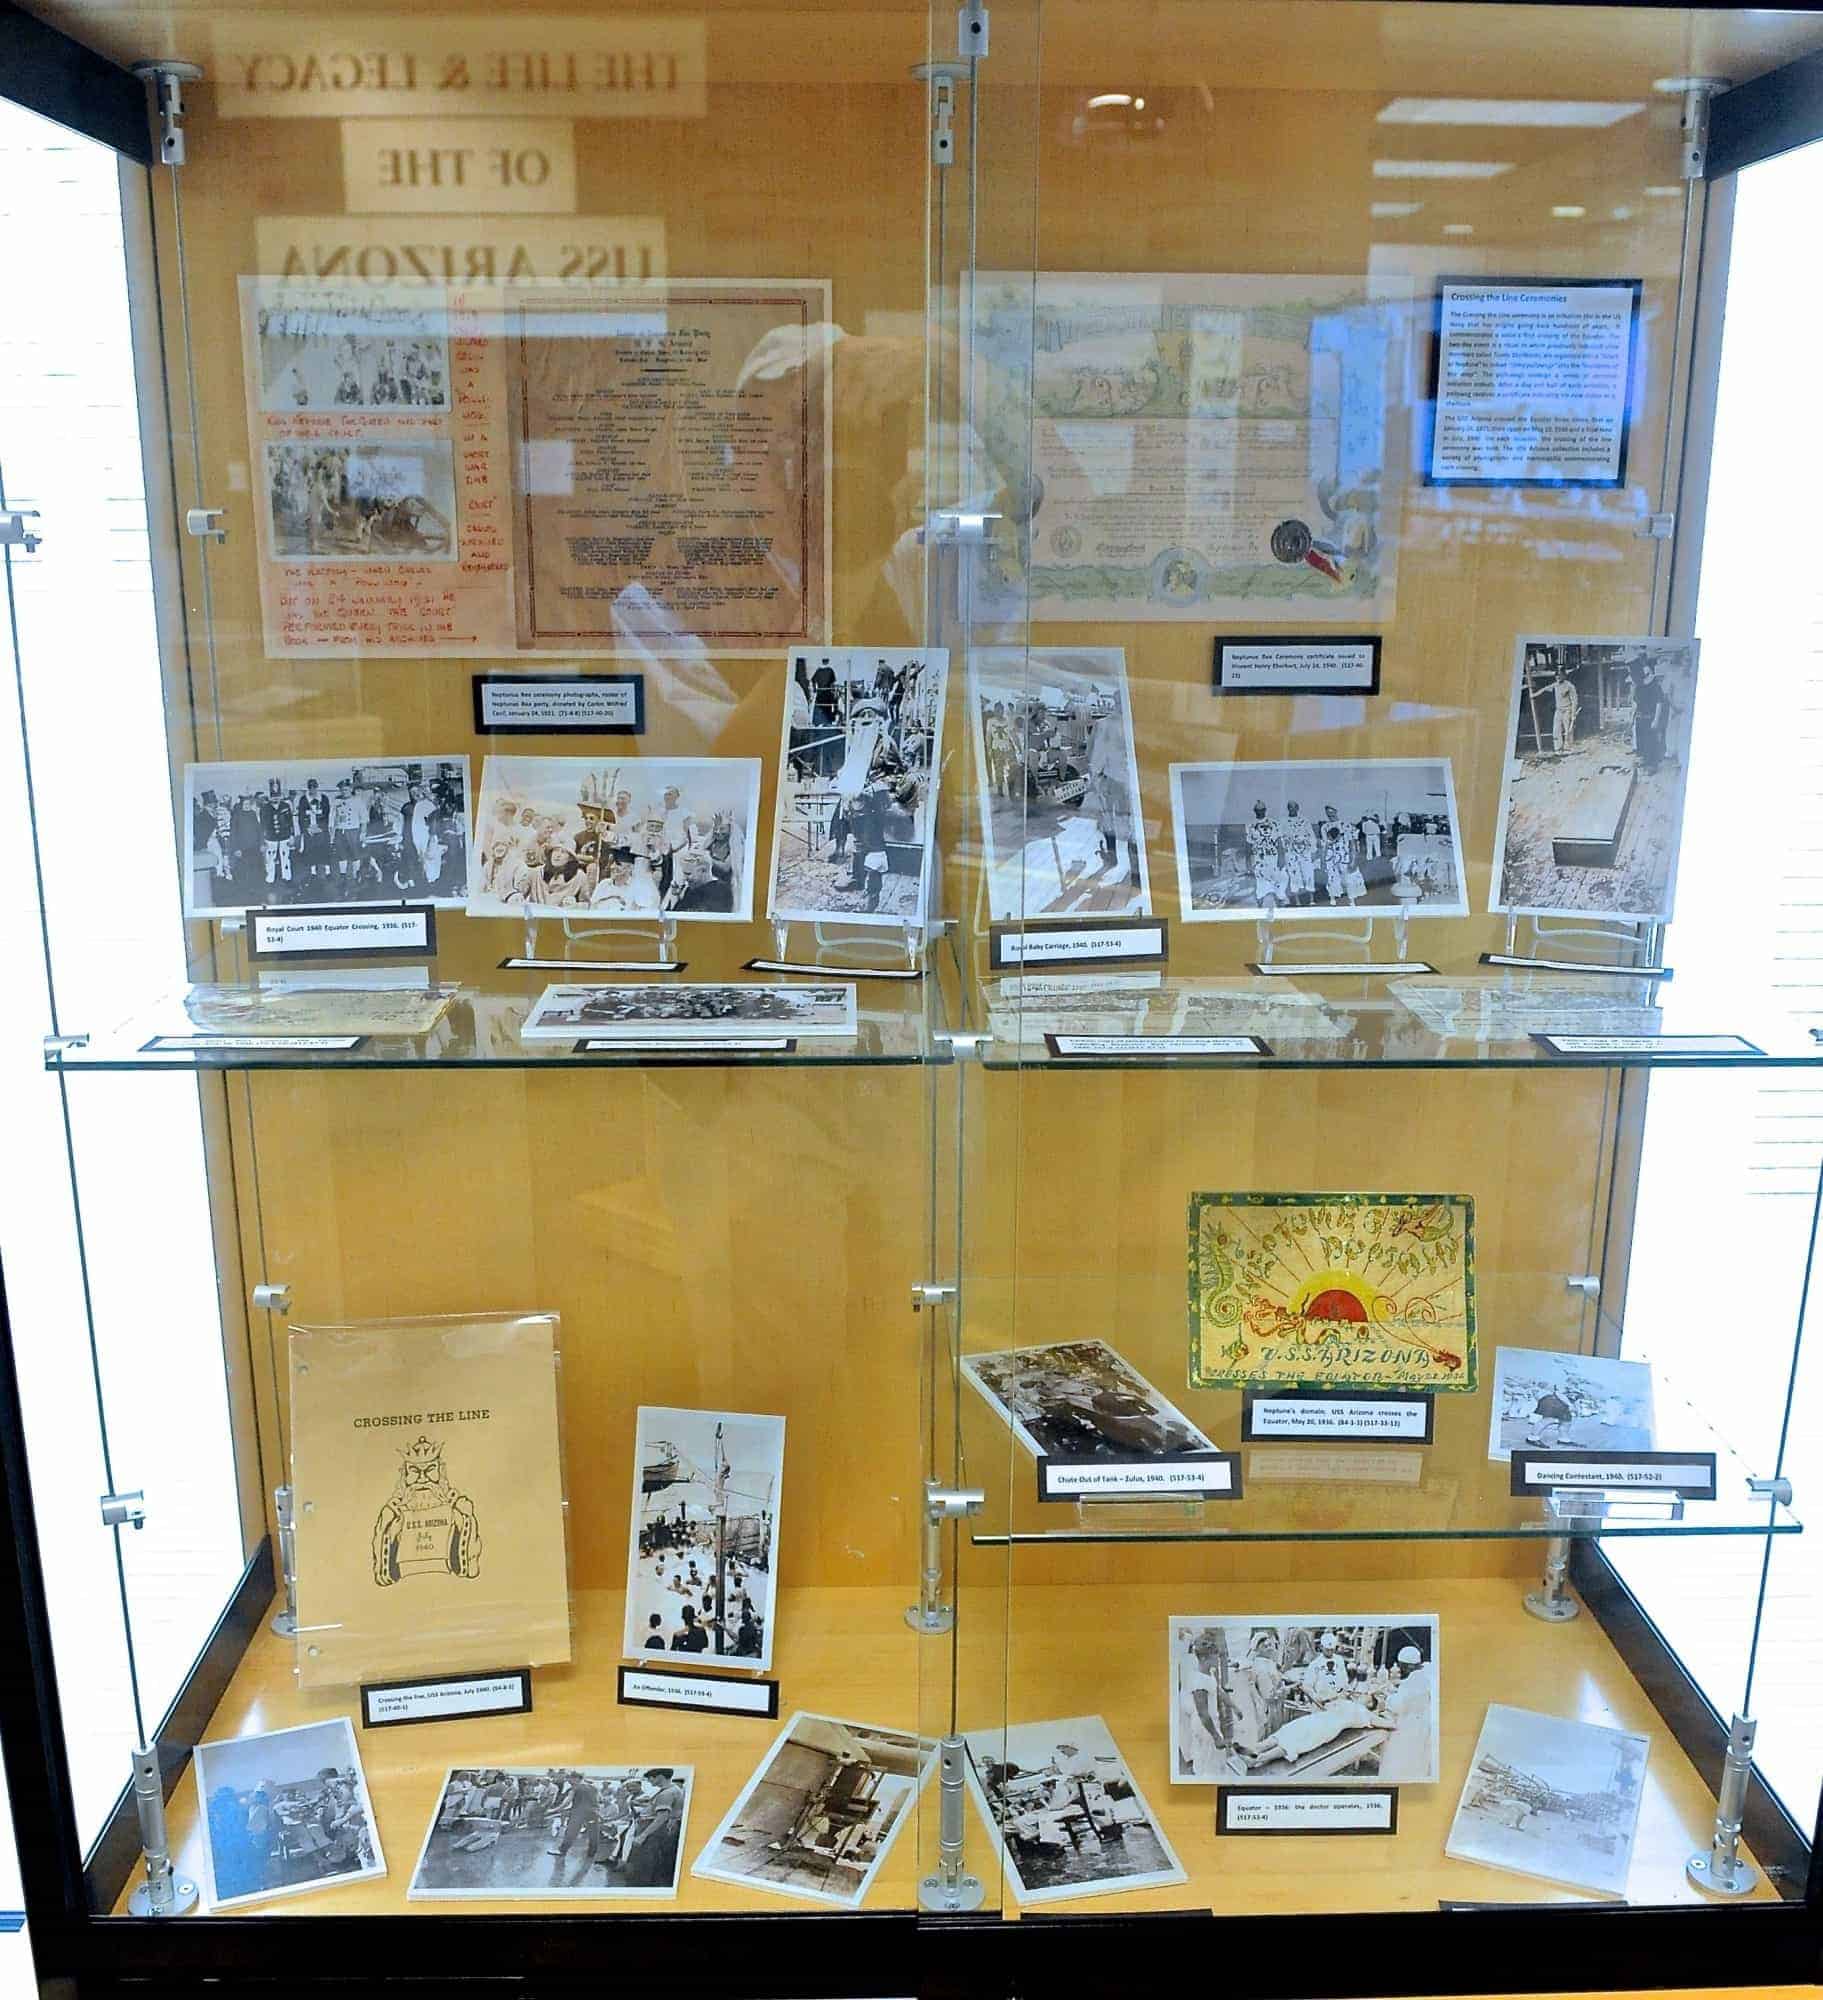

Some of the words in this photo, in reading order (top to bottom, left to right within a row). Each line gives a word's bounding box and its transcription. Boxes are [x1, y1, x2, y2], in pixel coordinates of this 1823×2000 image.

[1452, 293, 1483, 303] Crossing
[1487, 293, 1499, 301] the
[1502, 294, 1518, 302] Line
[1520, 294, 1566, 302] Ceremonies
[1277, 1371, 1304, 1379] THE
[1264, 1407, 1296, 1415] Neptune's
[354, 1415, 422, 1428] CROSSING
[428, 1412, 454, 1423] THE
[459, 1409, 490, 1420] LINE
[1292, 1418, 1305, 1426] May
[1080, 1475, 1091, 1483] Out
[1094, 1475, 1100, 1483] of
[1125, 1474, 1144, 1482] Zulus,
[1147, 1474, 1163, 1482] 1940.
[425, 1519, 448, 1528] ARIZONA
[1333, 1803, 1362, 1811] operates,
